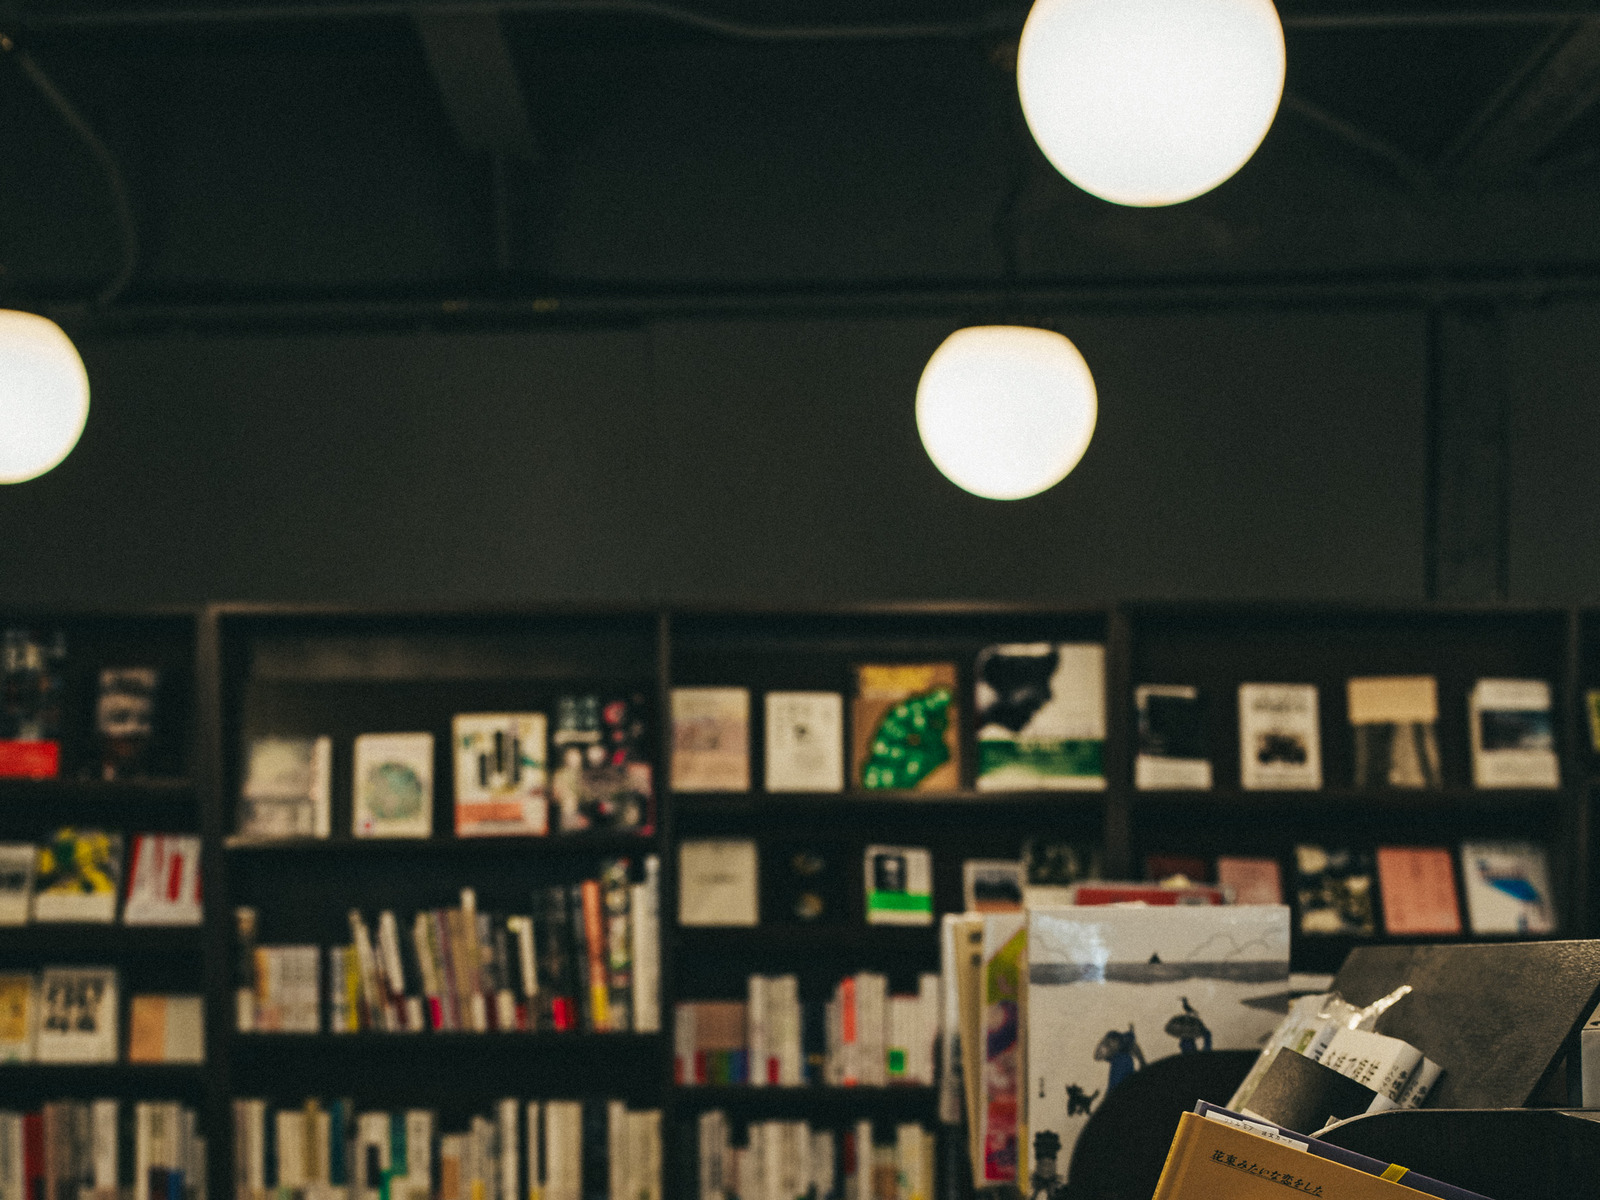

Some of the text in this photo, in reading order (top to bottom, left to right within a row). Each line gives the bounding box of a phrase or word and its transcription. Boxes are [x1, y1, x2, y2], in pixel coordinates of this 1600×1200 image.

[1211, 1149, 1323, 1196] 花束みたいな恋をした
